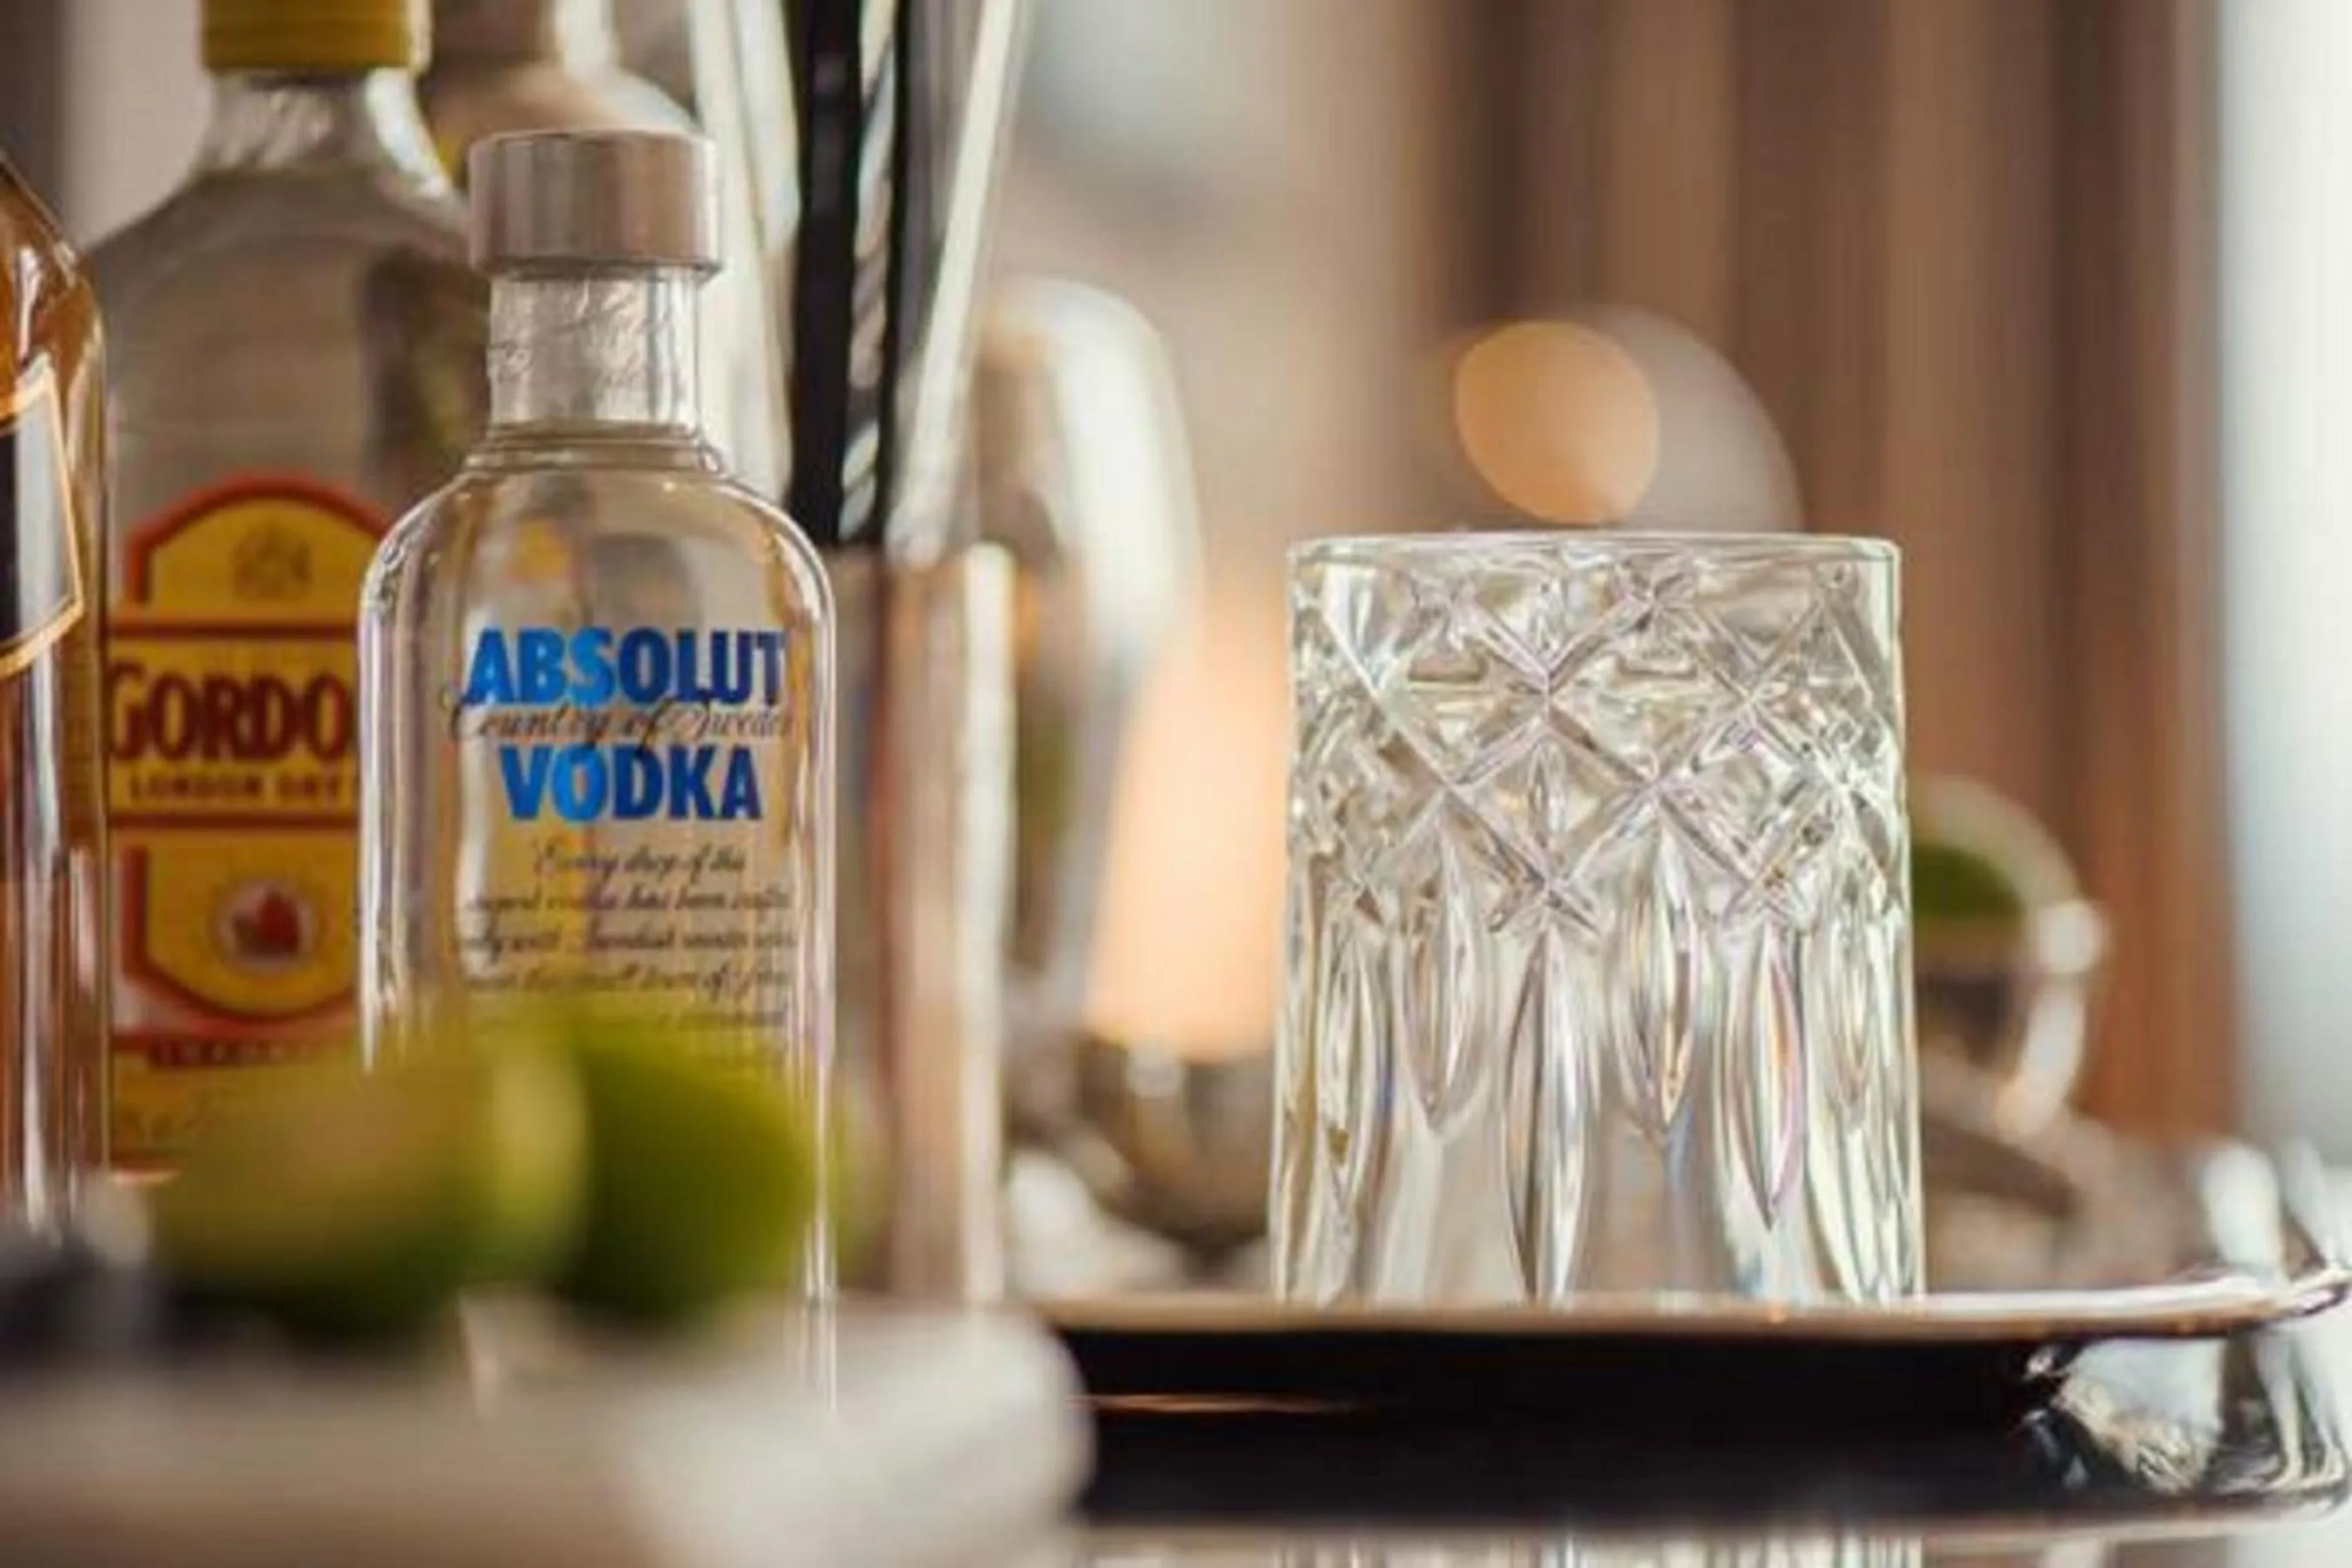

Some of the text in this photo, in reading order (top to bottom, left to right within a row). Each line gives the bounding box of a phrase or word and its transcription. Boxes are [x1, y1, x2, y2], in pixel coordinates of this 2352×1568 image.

[465, 626, 784, 706] ABSOLUT
[108, 659, 351, 761] GORDO
[498, 744, 763, 823] VODKA
